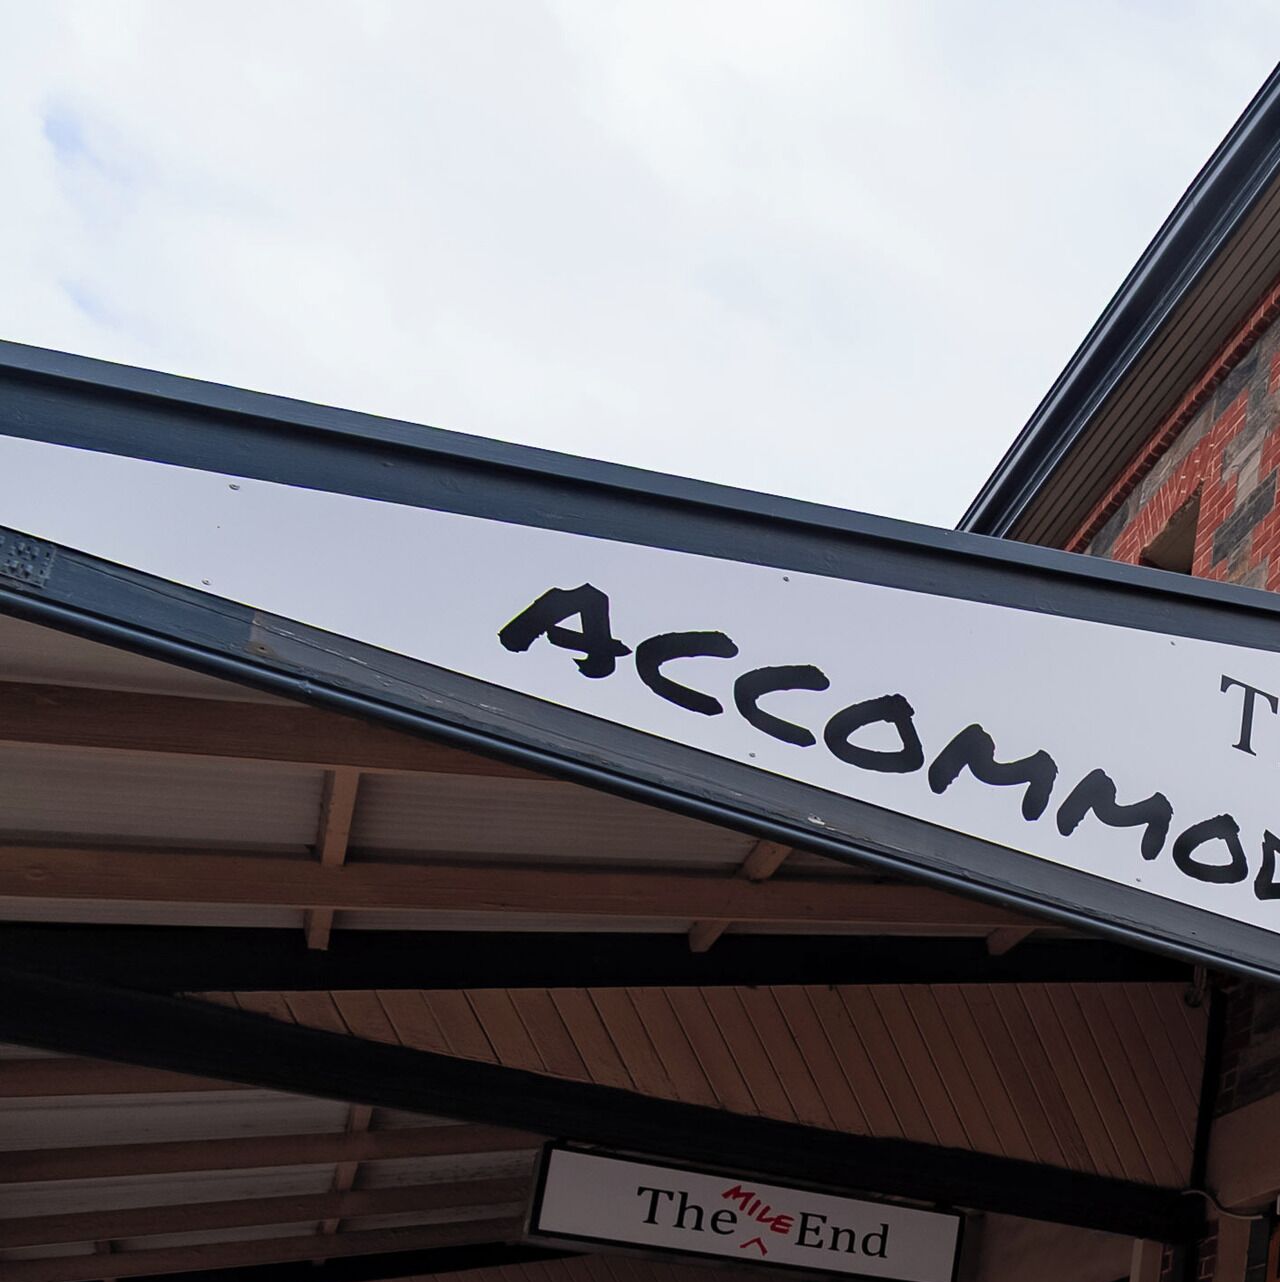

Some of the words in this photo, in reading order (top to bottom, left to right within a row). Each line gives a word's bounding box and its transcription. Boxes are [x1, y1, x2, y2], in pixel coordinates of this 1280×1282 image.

[637, 1187, 738, 1236] The
[721, 1185, 795, 1235] MILE
[794, 1211, 889, 1259] End
